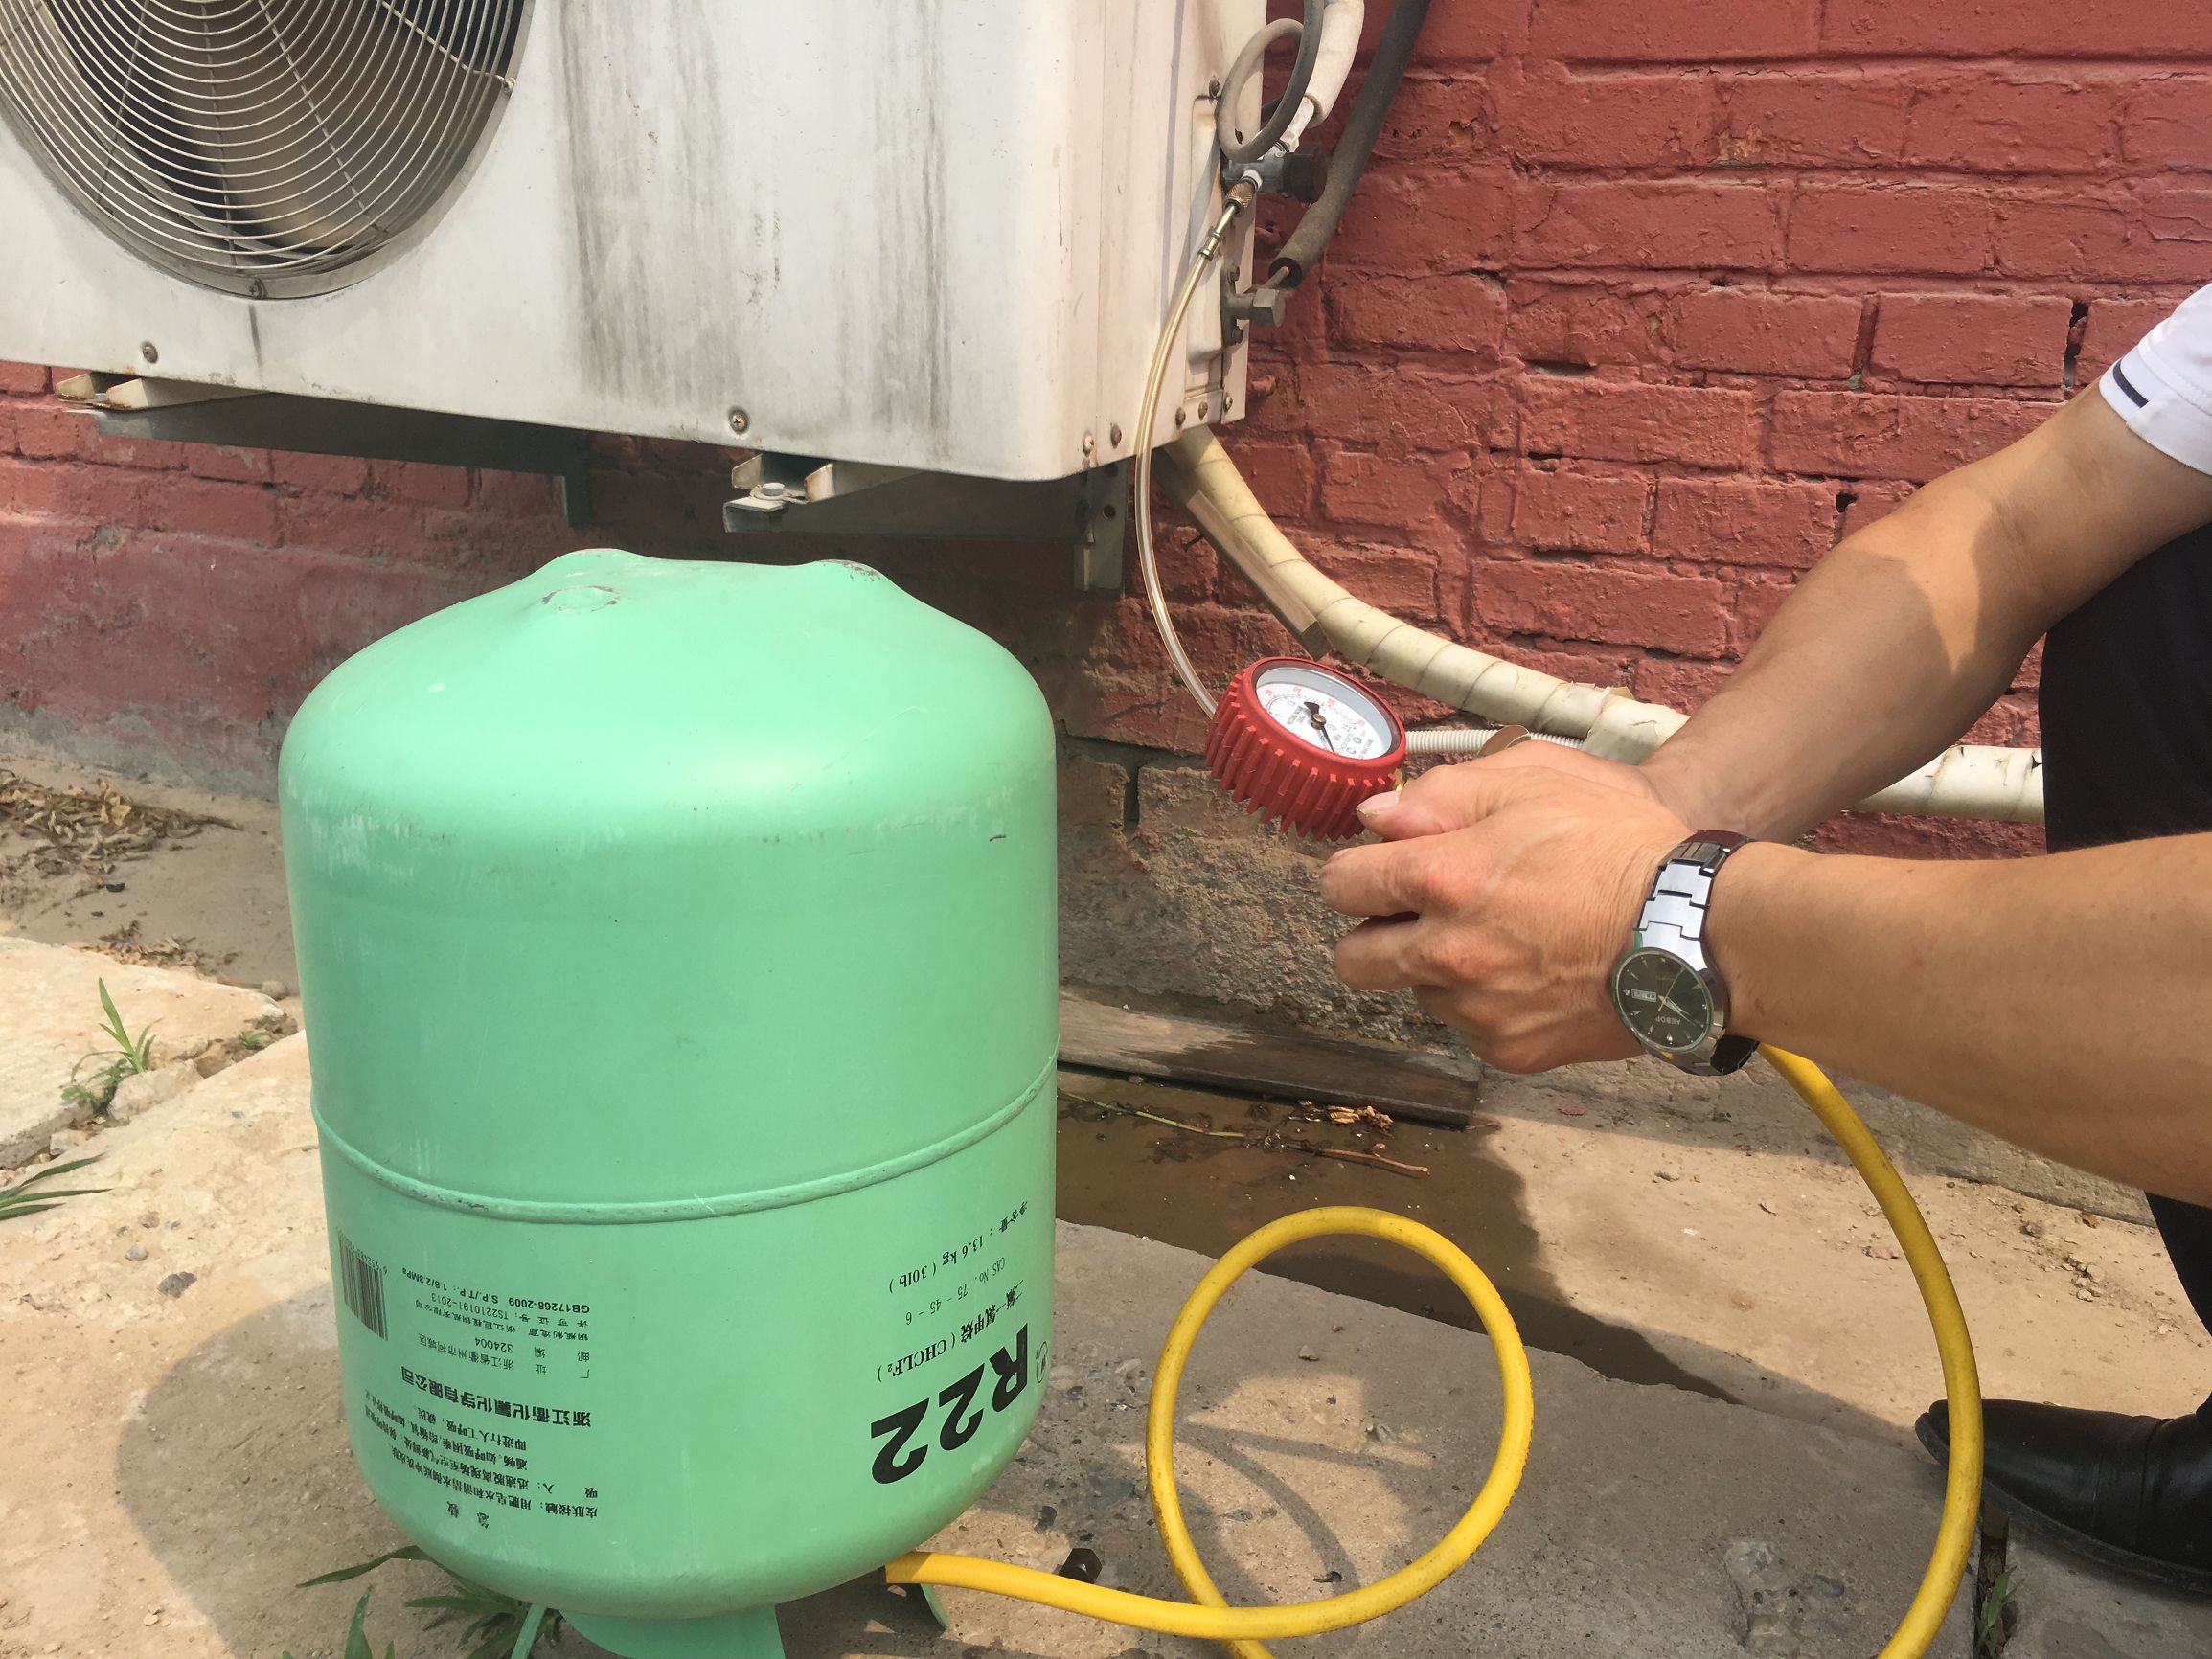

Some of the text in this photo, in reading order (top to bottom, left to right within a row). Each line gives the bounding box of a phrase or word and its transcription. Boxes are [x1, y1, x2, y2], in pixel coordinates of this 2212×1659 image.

[962, 1235, 983, 1258] 13.6
[942, 1250, 957, 1266] kg
[992, 1256, 1005, 1276] CAS
[508, 1297, 590, 1313] GB17268-2009
[474, 1337, 513, 1353] 324004
[401, 1366, 591, 1427] 浙江衢化氟化学有限公司
[871, 1323, 1027, 1484] R22
